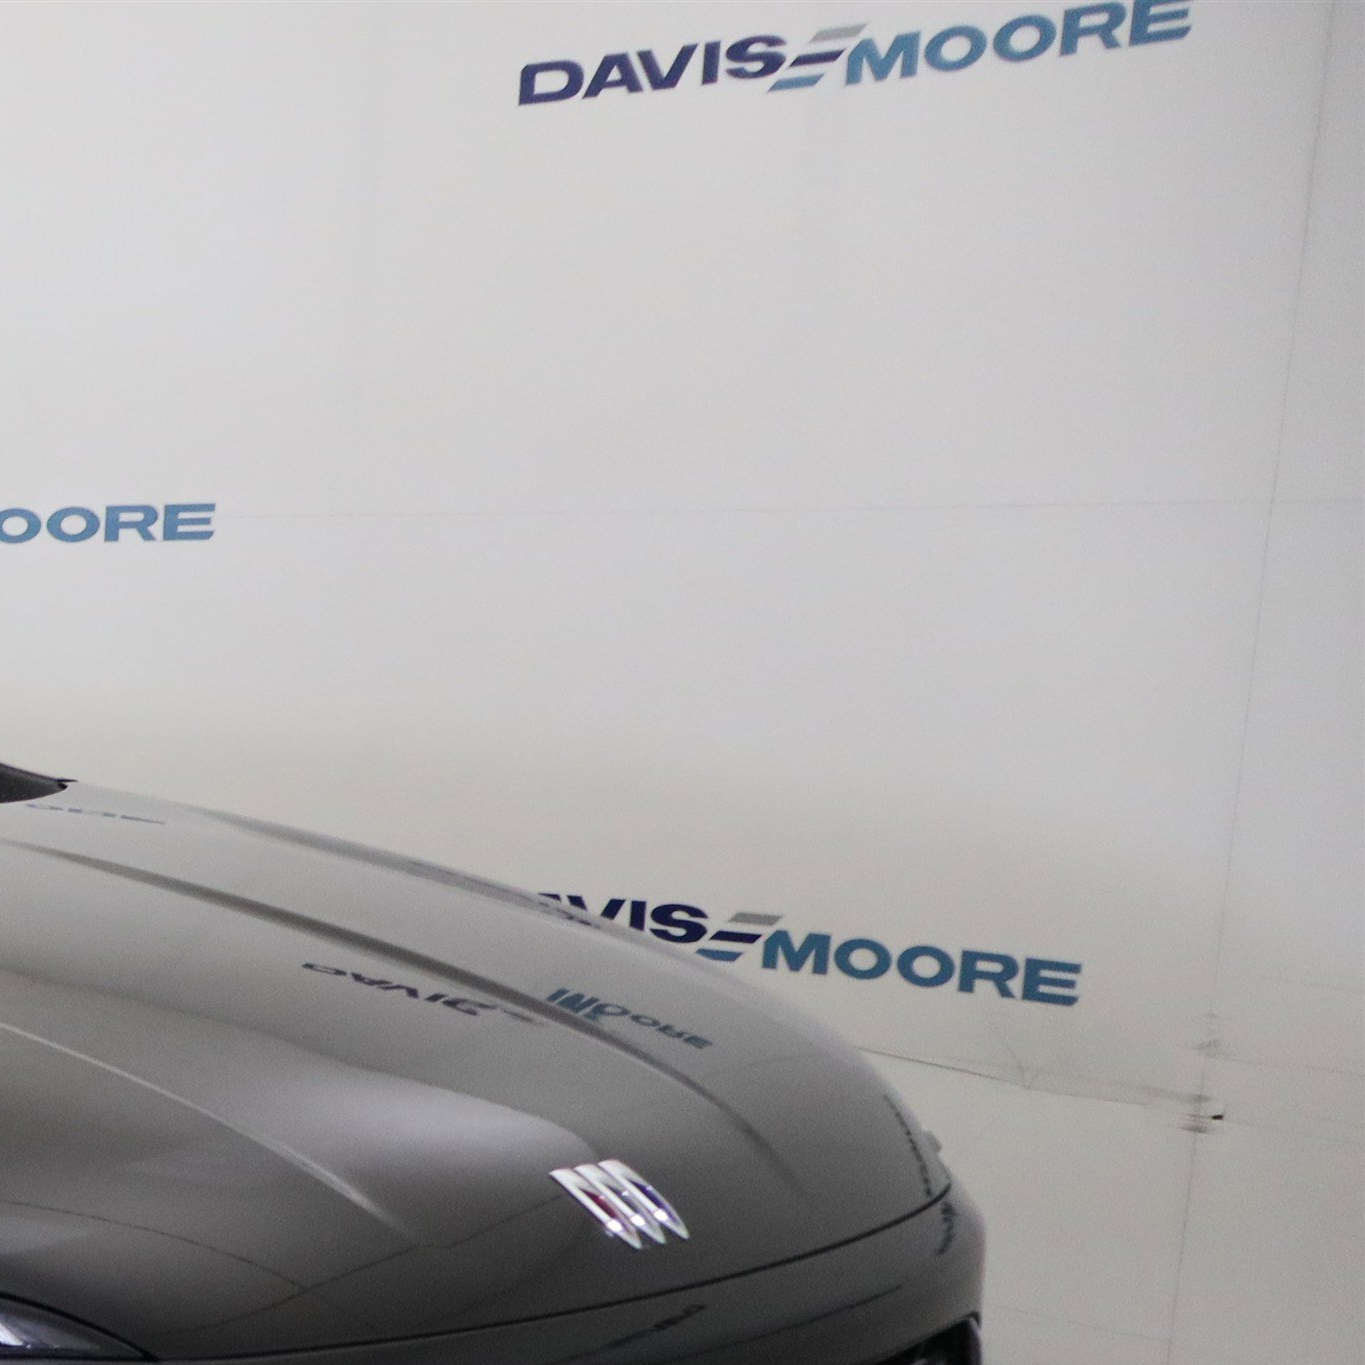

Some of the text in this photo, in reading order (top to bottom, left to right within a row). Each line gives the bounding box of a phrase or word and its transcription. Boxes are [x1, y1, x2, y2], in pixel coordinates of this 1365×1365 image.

[518, 0, 1194, 107] DAVIS MOORE
[537, 892, 1084, 1008] VIS MOORE
